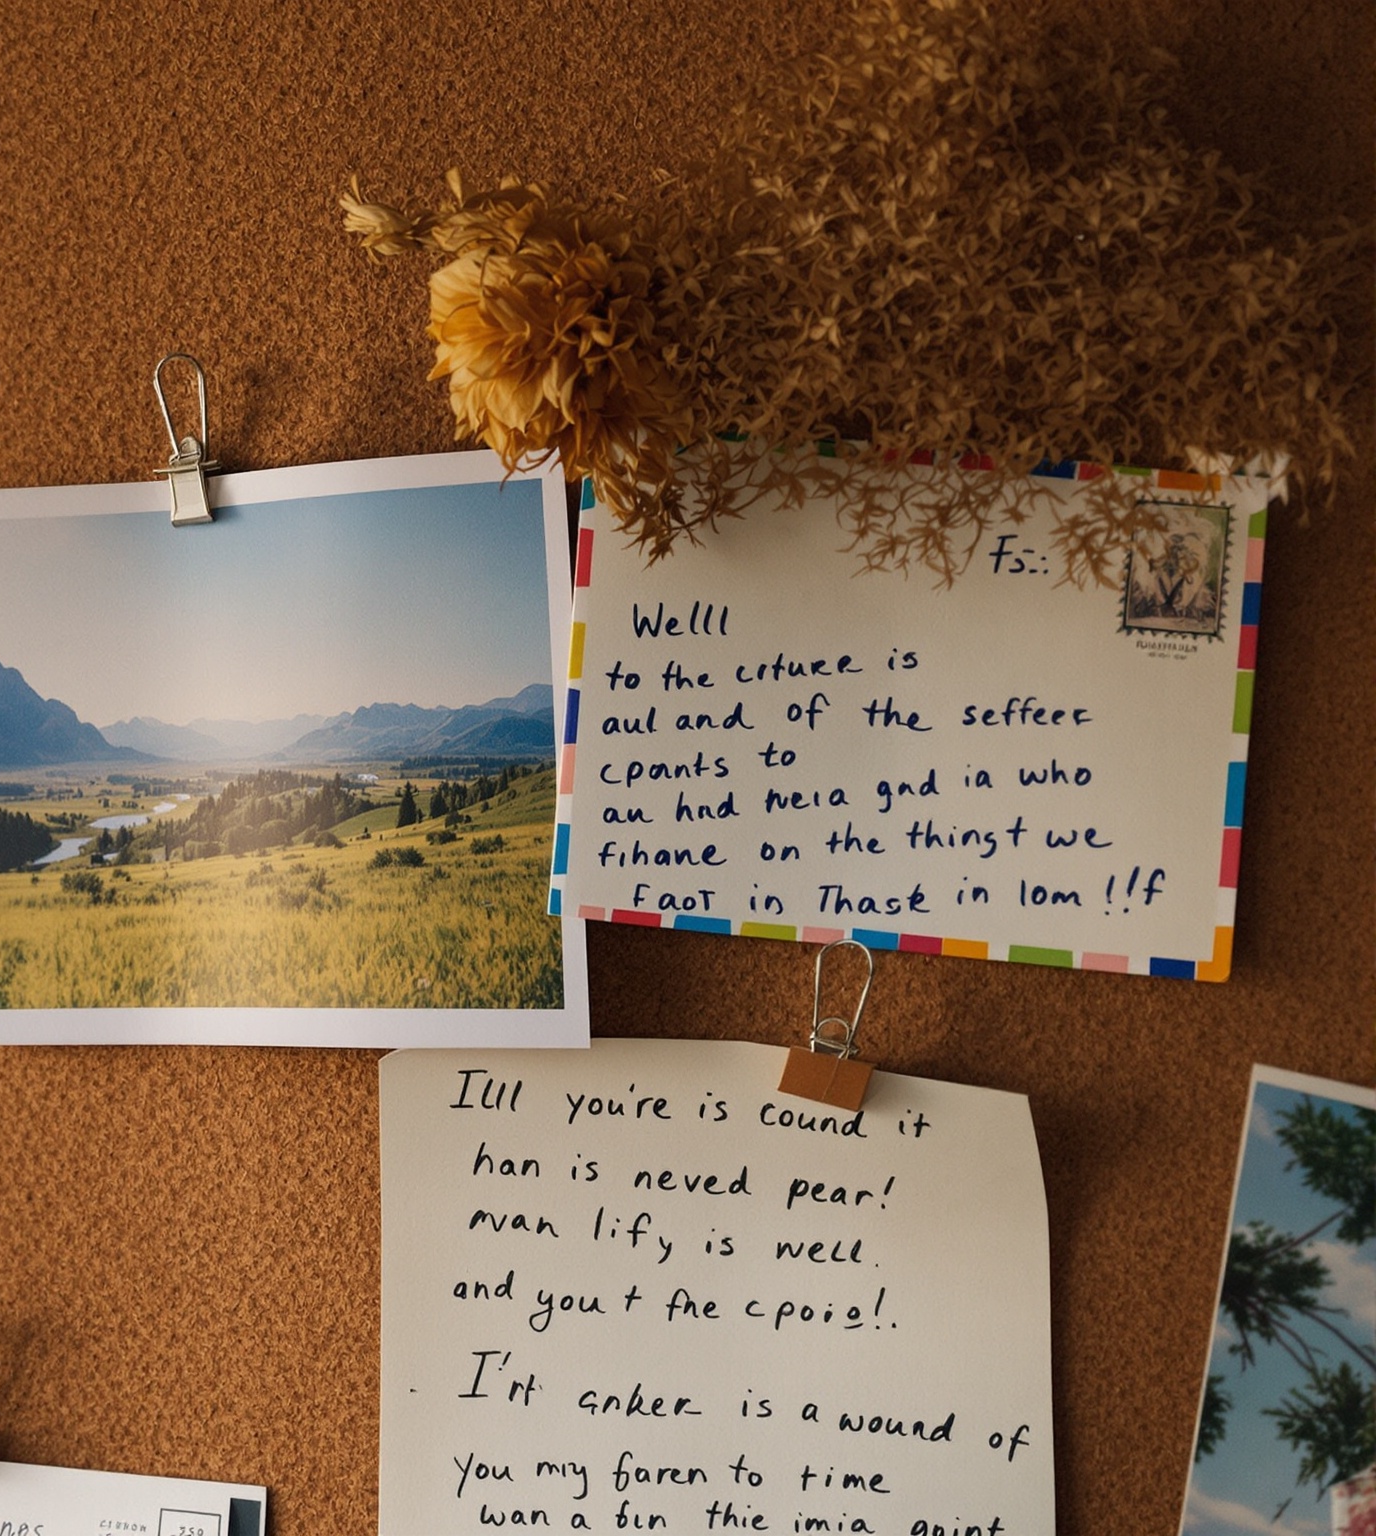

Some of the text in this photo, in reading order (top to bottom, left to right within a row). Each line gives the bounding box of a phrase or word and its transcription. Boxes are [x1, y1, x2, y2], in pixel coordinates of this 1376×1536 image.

[604, 660, 641, 692] to
[661, 660, 715, 692] the
[887, 647, 919, 671] is
[675, 701, 755, 731] and
[786, 692, 831, 731] of
[861, 696, 933, 732] the
[757, 741, 797, 769] to
[964, 763, 994, 789] ia
[1018, 758, 1092, 787] who
[759, 841, 800, 862] on
[824, 821, 886, 855] the
[1045, 827, 1114, 849] we
[956, 876, 989, 906] in
[565, 1082, 672, 1125] you're
[698, 1091, 729, 1122] is
[898, 1108, 932, 1139] it
[472, 1141, 540, 1178] han
[570, 1153, 599, 1183] is
[633, 1165, 752, 1196] neved
[705, 1227, 735, 1257] is
[452, 1269, 515, 1301] and
[528, 1289, 607, 1333] you
[741, 1388, 773, 1419] is
[801, 1402, 820, 1423] a
[838, 1412, 956, 1443] wound
[988, 1423, 1030, 1463] of
[728, 1453, 764, 1488] to
[800, 1464, 891, 1494] time
[479, 1503, 551, 1528] wan
[570, 1512, 592, 1531] a
